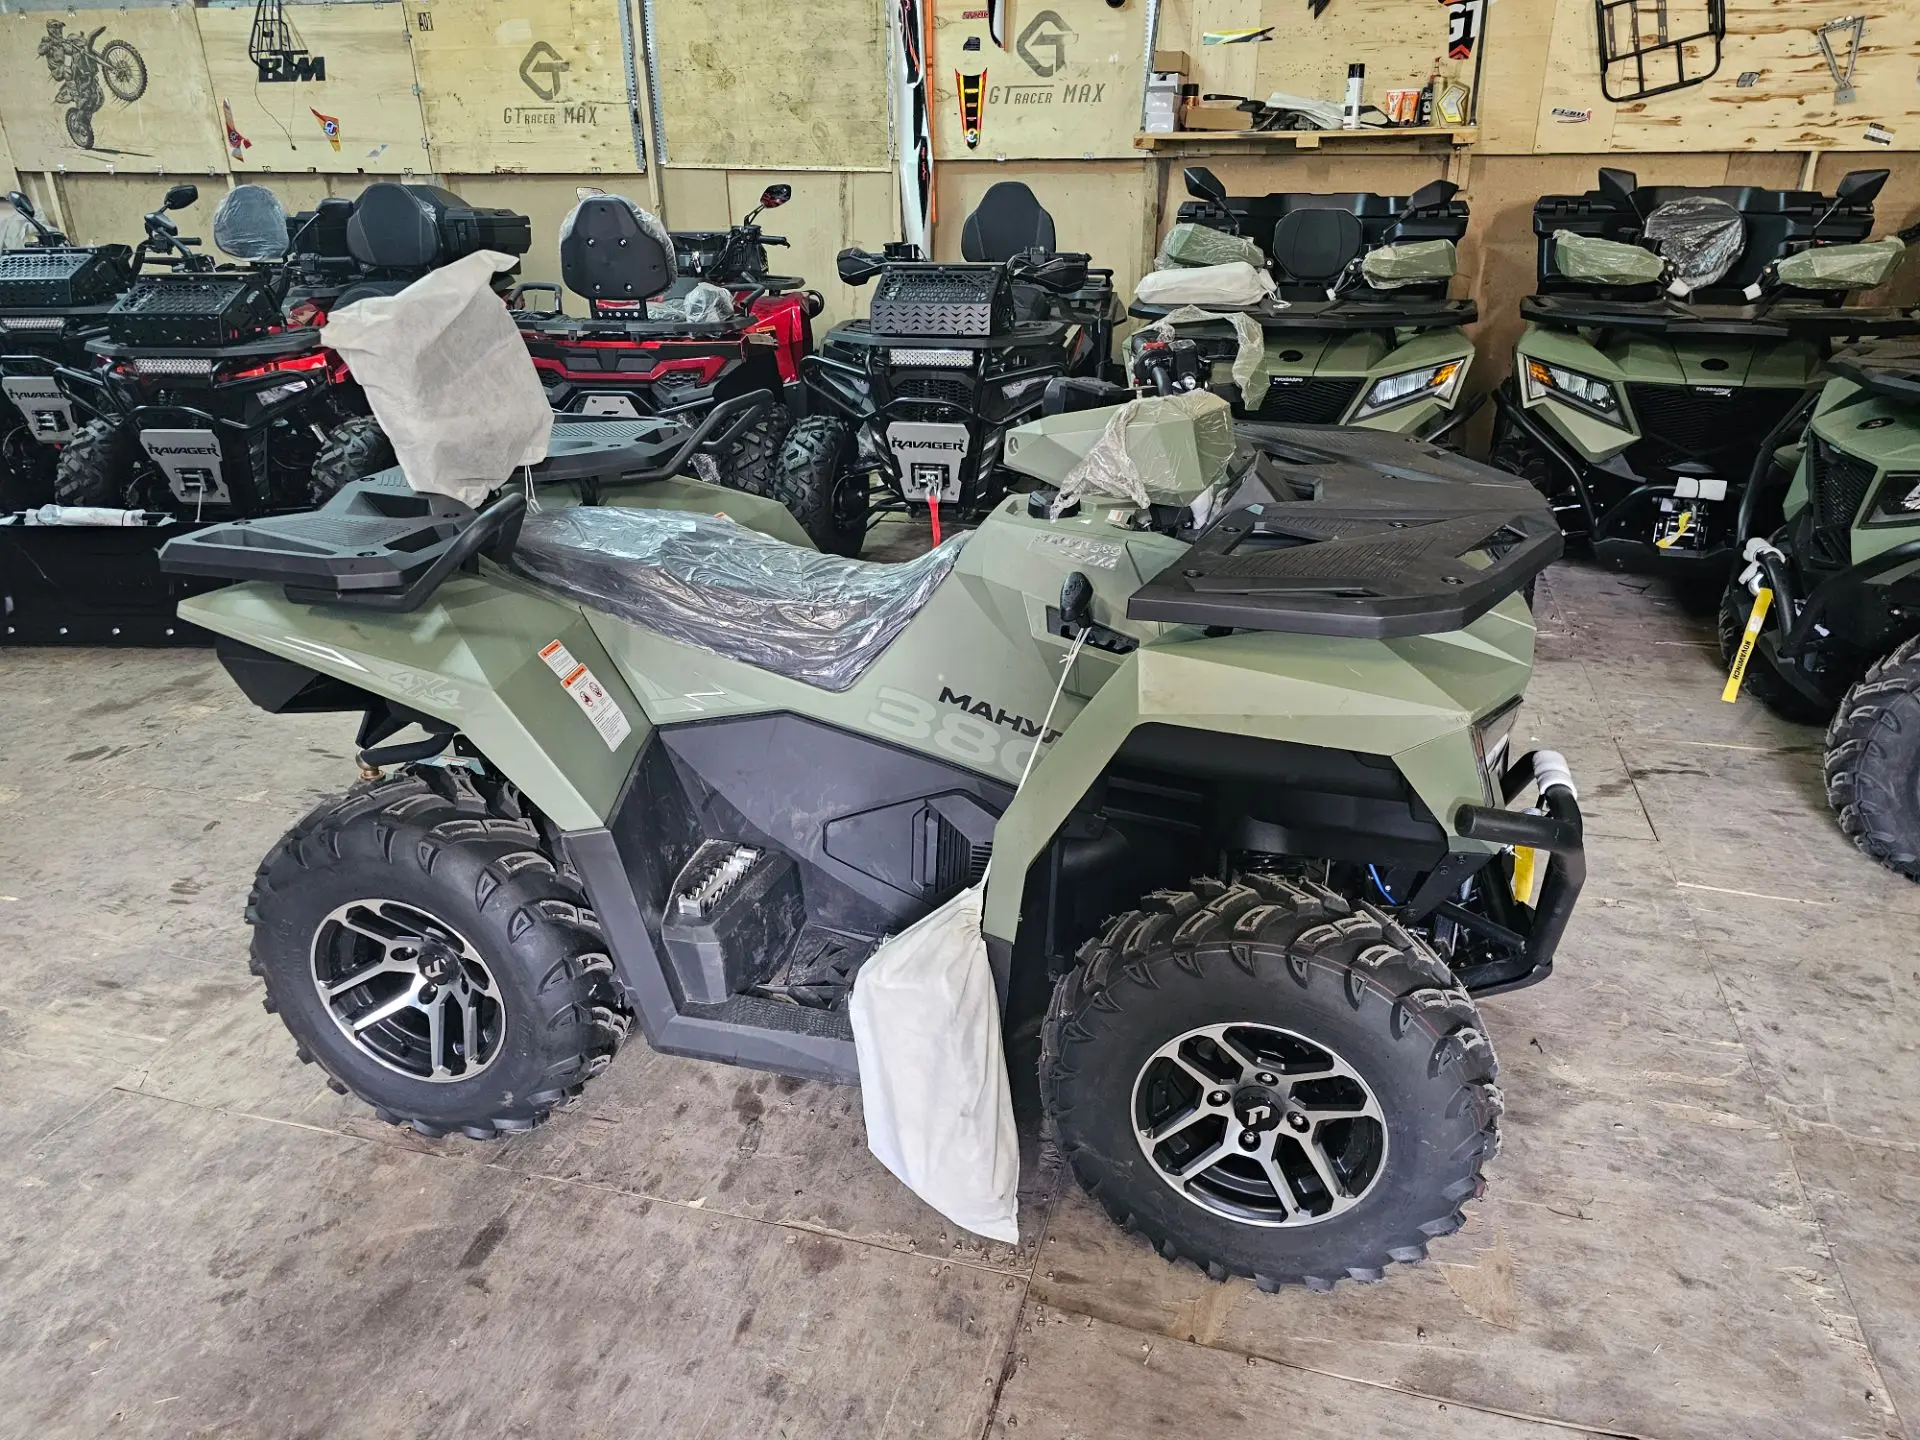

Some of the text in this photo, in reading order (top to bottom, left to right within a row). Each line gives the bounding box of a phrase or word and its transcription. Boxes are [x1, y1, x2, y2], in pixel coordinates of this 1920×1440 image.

[1062, 83, 1106, 103] MAX
[564, 106, 598, 124] MAX
[148, 446, 221, 458] RAVAGER
[891, 440, 965, 453] RAVAGER
[1733, 640, 1751, 680] NOVAWINCH
